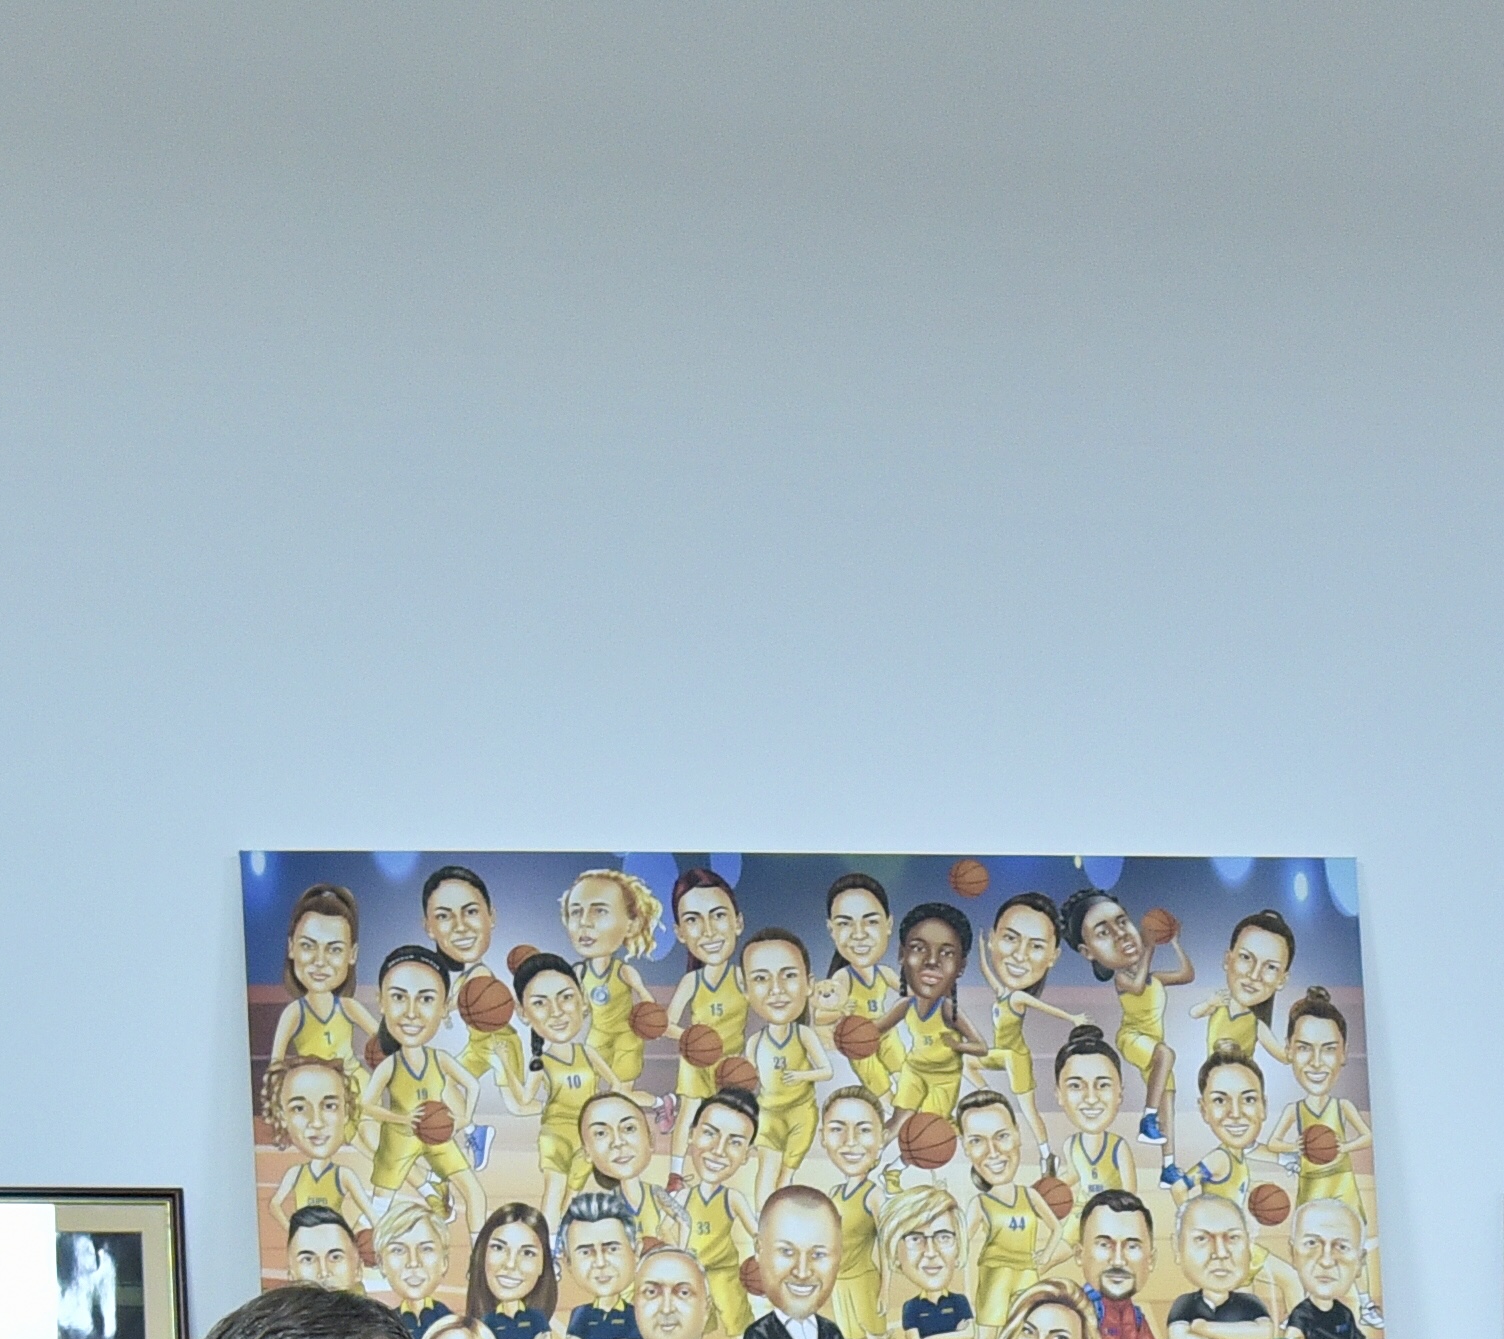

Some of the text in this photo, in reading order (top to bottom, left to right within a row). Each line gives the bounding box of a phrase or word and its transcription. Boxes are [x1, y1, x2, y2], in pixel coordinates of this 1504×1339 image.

[709, 1002, 724, 1018] 15
[867, 999, 878, 1012] 13
[323, 1031, 332, 1045] 7
[772, 1056, 788, 1070] 23
[567, 1075, 582, 1089] 10
[696, 1221, 711, 1235] 33
[1009, 1215, 1026, 1232] 44
